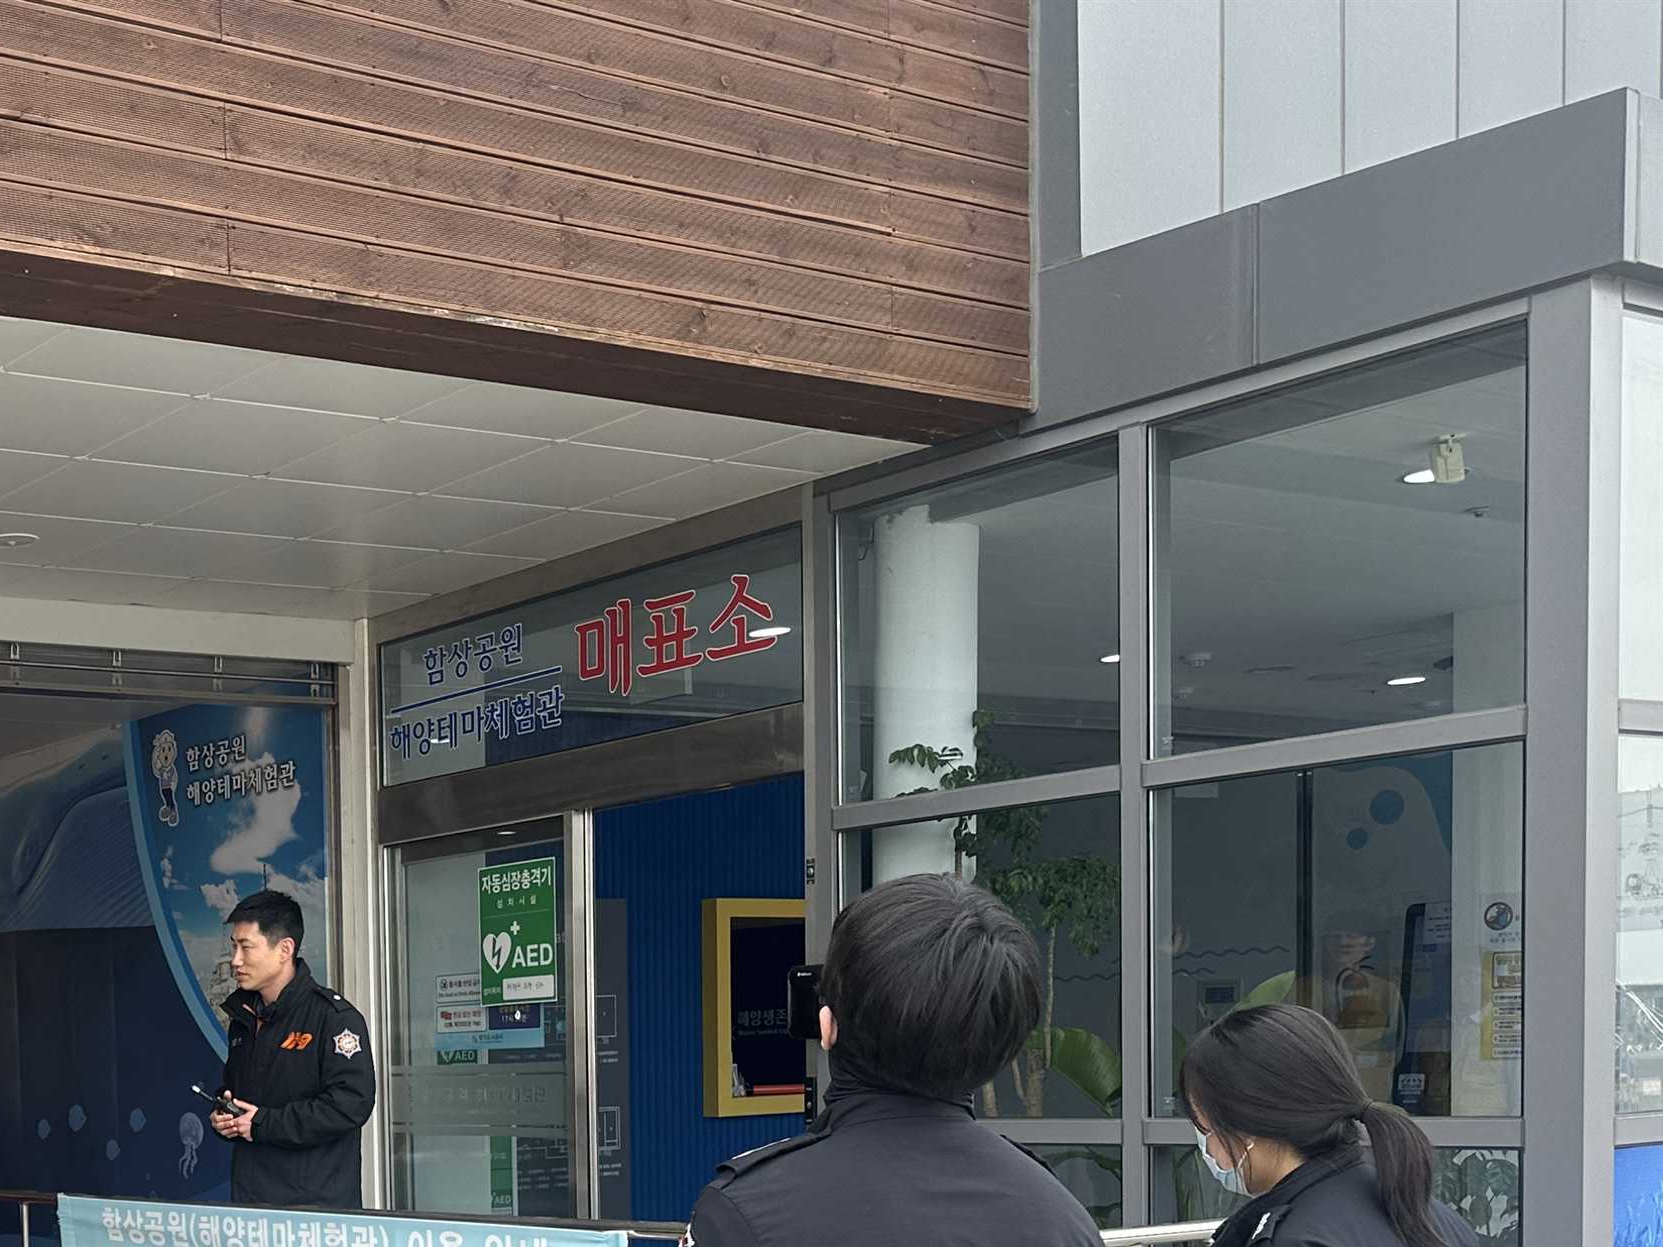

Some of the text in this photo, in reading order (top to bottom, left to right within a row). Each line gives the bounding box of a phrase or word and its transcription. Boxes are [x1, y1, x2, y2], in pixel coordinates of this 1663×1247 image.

[422, 622, 524, 686] 함상공원
[574, 573, 779, 697] 매표소
[388, 683, 565, 762] 해양테마체험관
[185, 735, 247, 773] 함상공원
[186, 760, 296, 807] 해양테마체험관
[481, 865, 552, 895] 자동심장충격기
[511, 943, 554, 969] AED
